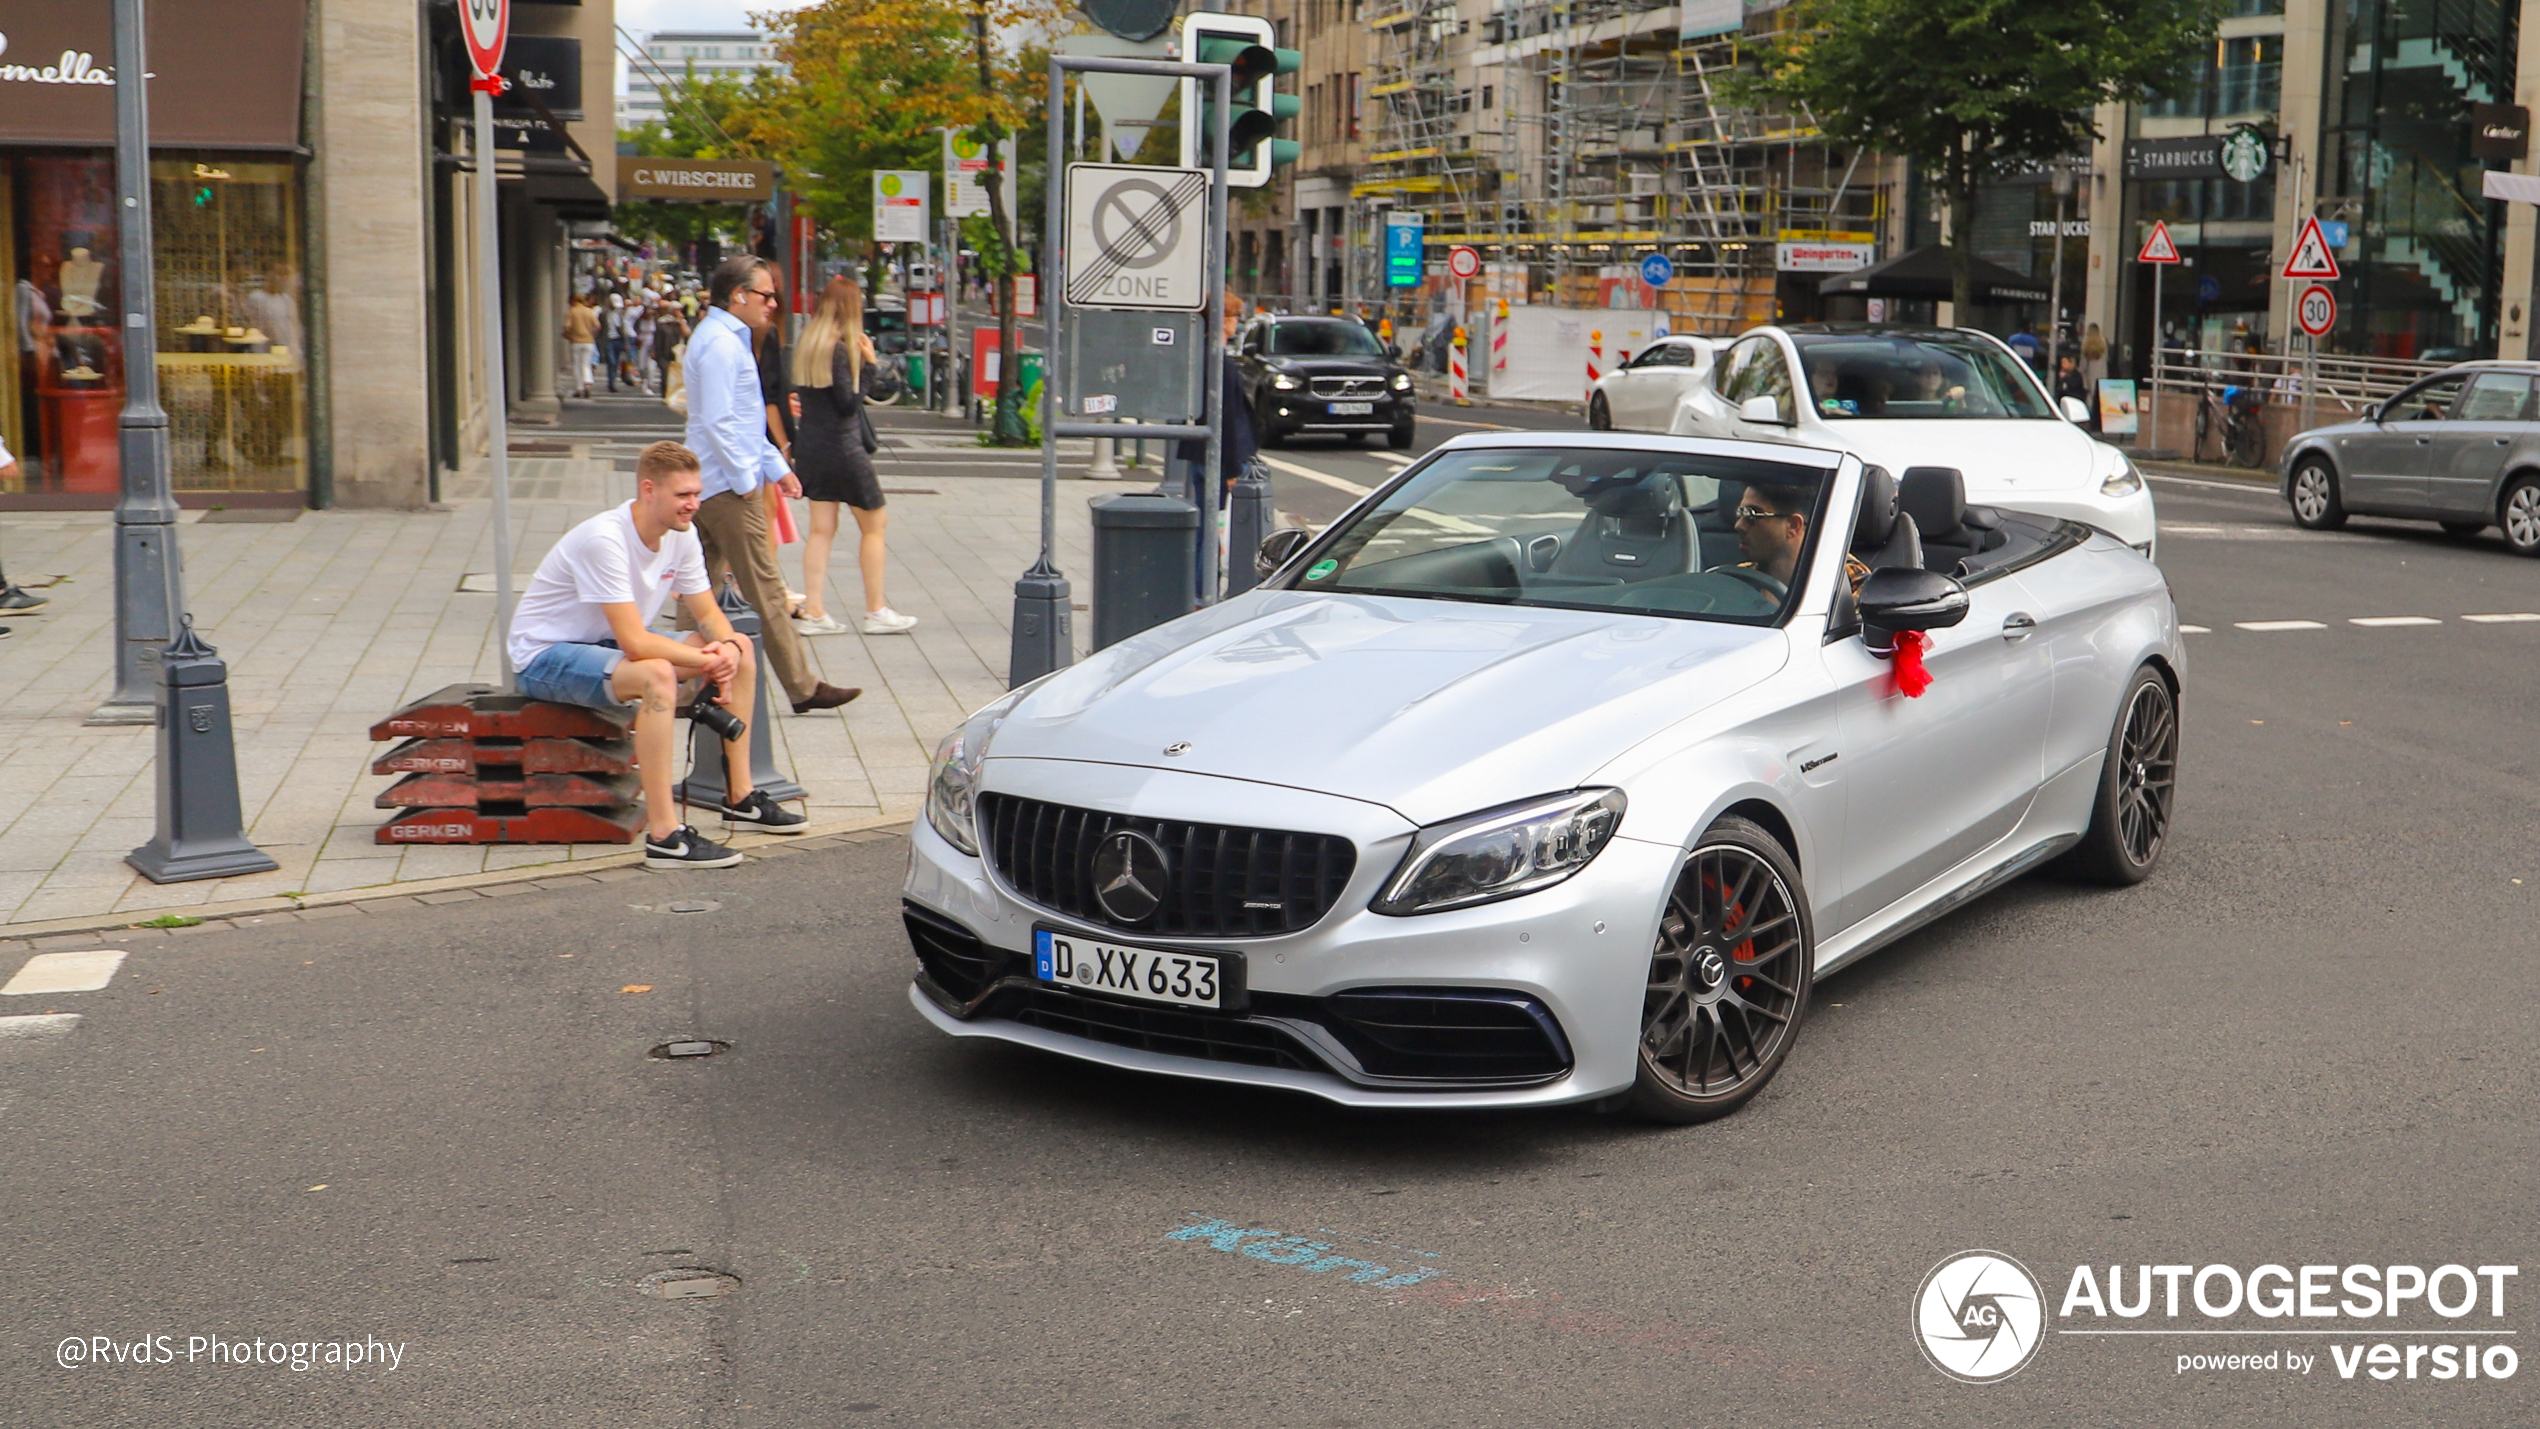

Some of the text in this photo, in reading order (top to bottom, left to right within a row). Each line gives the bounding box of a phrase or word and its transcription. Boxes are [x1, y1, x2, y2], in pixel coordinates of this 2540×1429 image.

[2143, 150, 2214, 168] STARBUCKS
[2029, 221, 2090, 236] STARUCKS
[1793, 247, 1854, 261] Weingarten
[1103, 276, 1169, 298] ZONE
[1990, 287, 2047, 300] STARBUCKS
[2305, 300, 2327, 321] 30
[391, 824, 472, 838] GERKEN
[1041, 960, 1049, 972] D
[1054, 940, 1216, 1001] D XX 633
